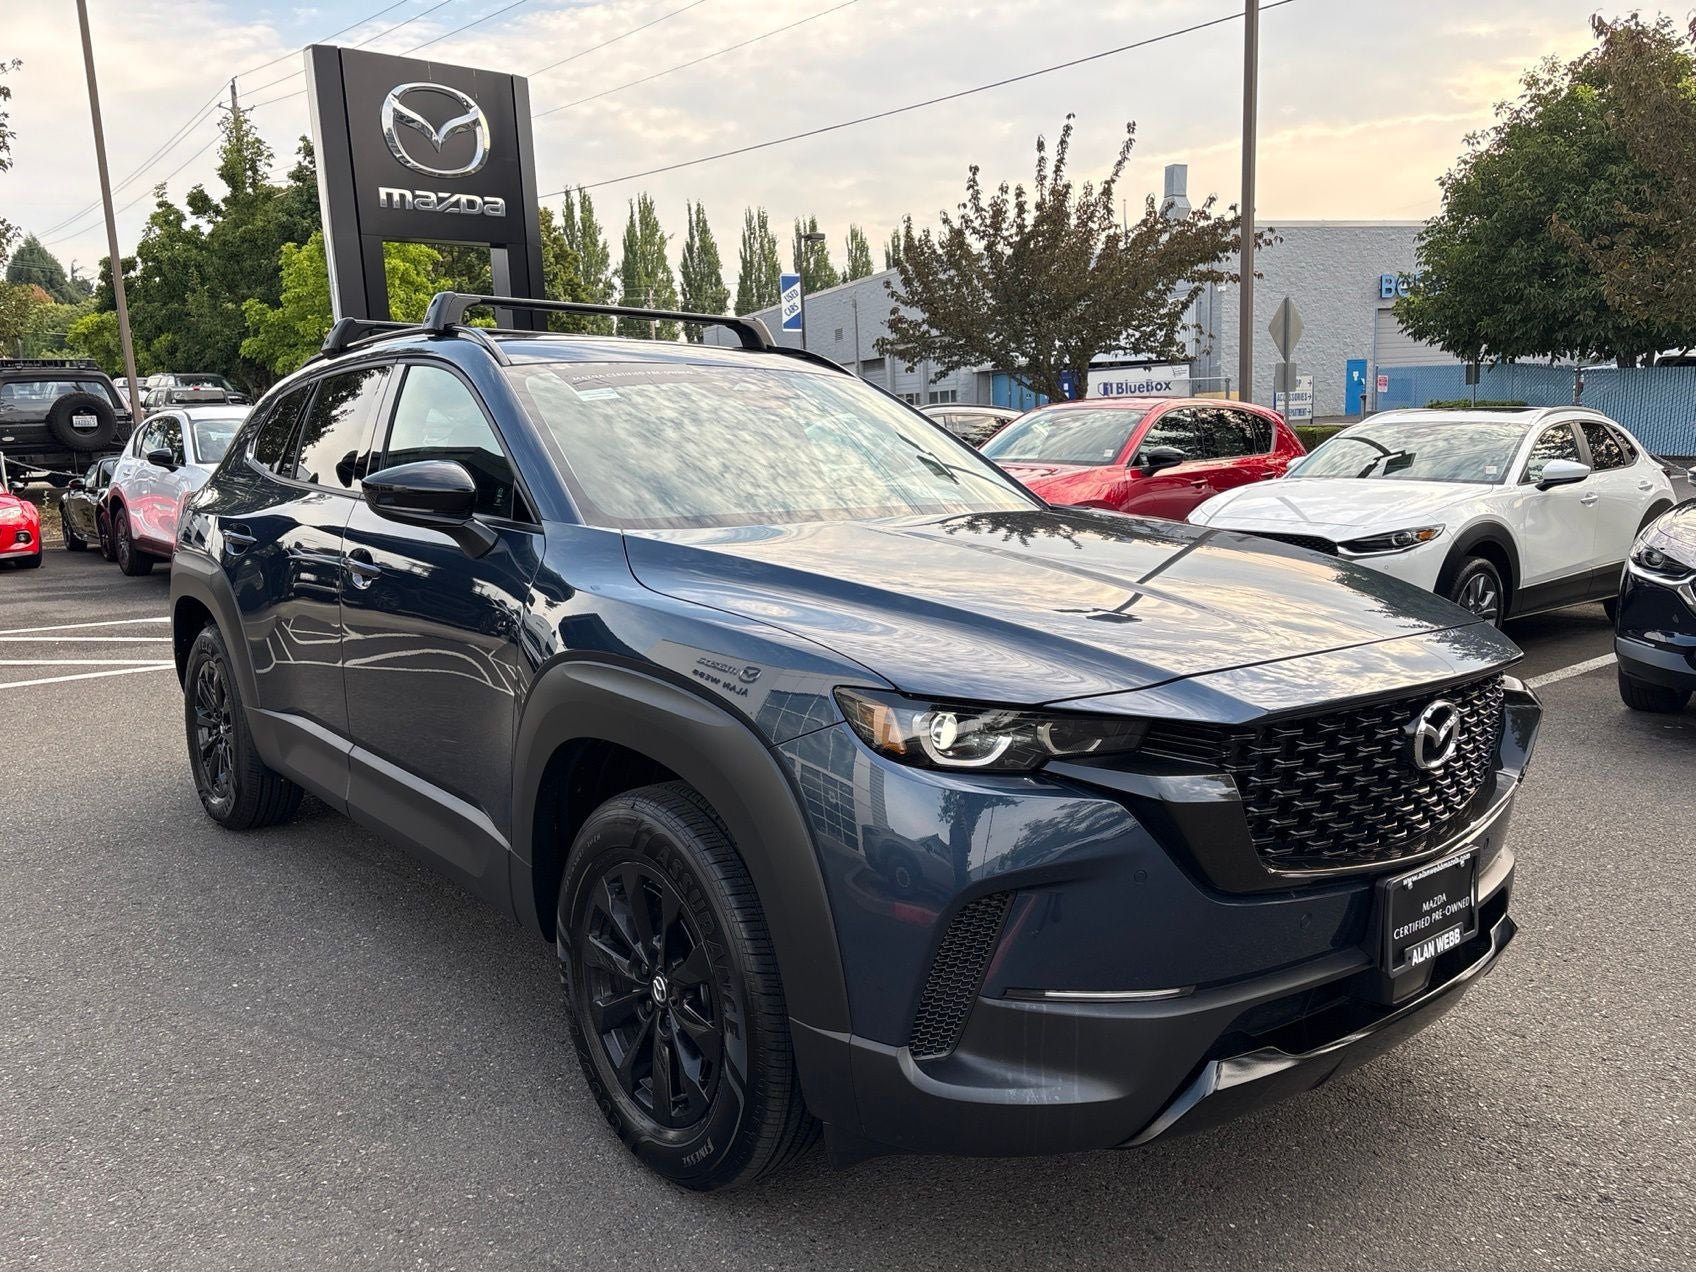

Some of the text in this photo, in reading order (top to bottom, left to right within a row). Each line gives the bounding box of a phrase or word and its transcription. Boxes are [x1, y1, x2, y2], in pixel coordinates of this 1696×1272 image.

[783, 288, 799, 303] USED
[784, 302, 799, 317] CARS
[1116, 379, 1173, 395] BlueBox
[1422, 892, 1447, 913] MAZDA
[1393, 896, 1470, 940] CERTIFIED PRE-OWNED
[1411, 928, 1461, 967] ALAN WEBB
